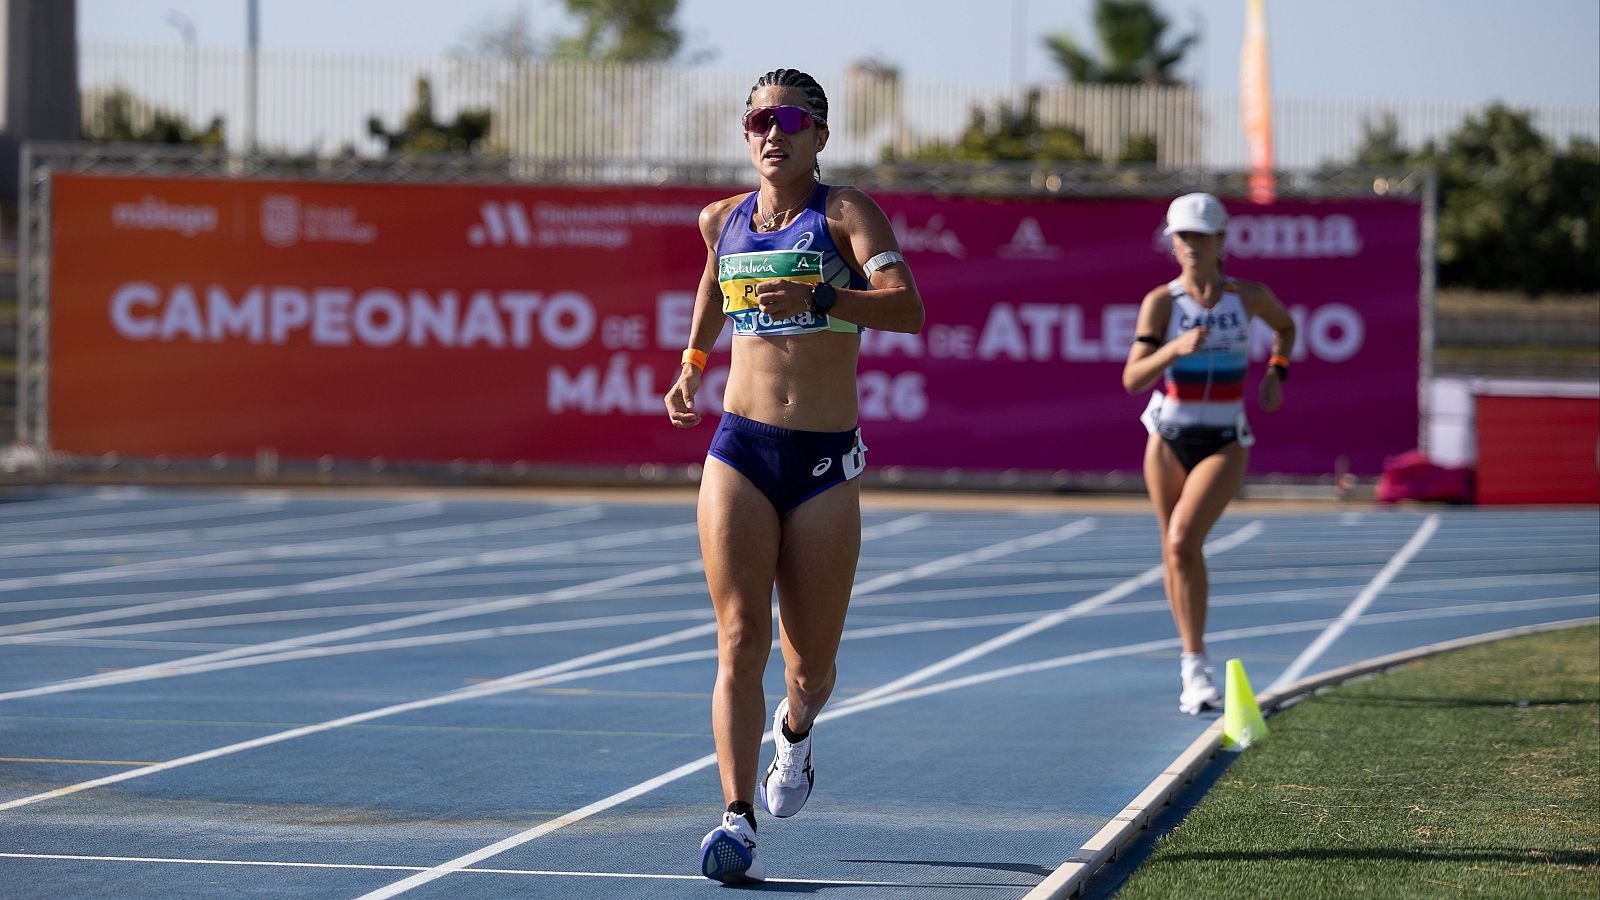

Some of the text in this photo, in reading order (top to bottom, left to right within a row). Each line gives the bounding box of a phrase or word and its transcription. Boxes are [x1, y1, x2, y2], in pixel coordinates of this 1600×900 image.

[1223, 213, 1360, 258] oma
[109, 281, 595, 348] CAMPEONATO
[977, 302, 1364, 363] ATLEMO
[547, 352, 929, 423] MÁL 26
